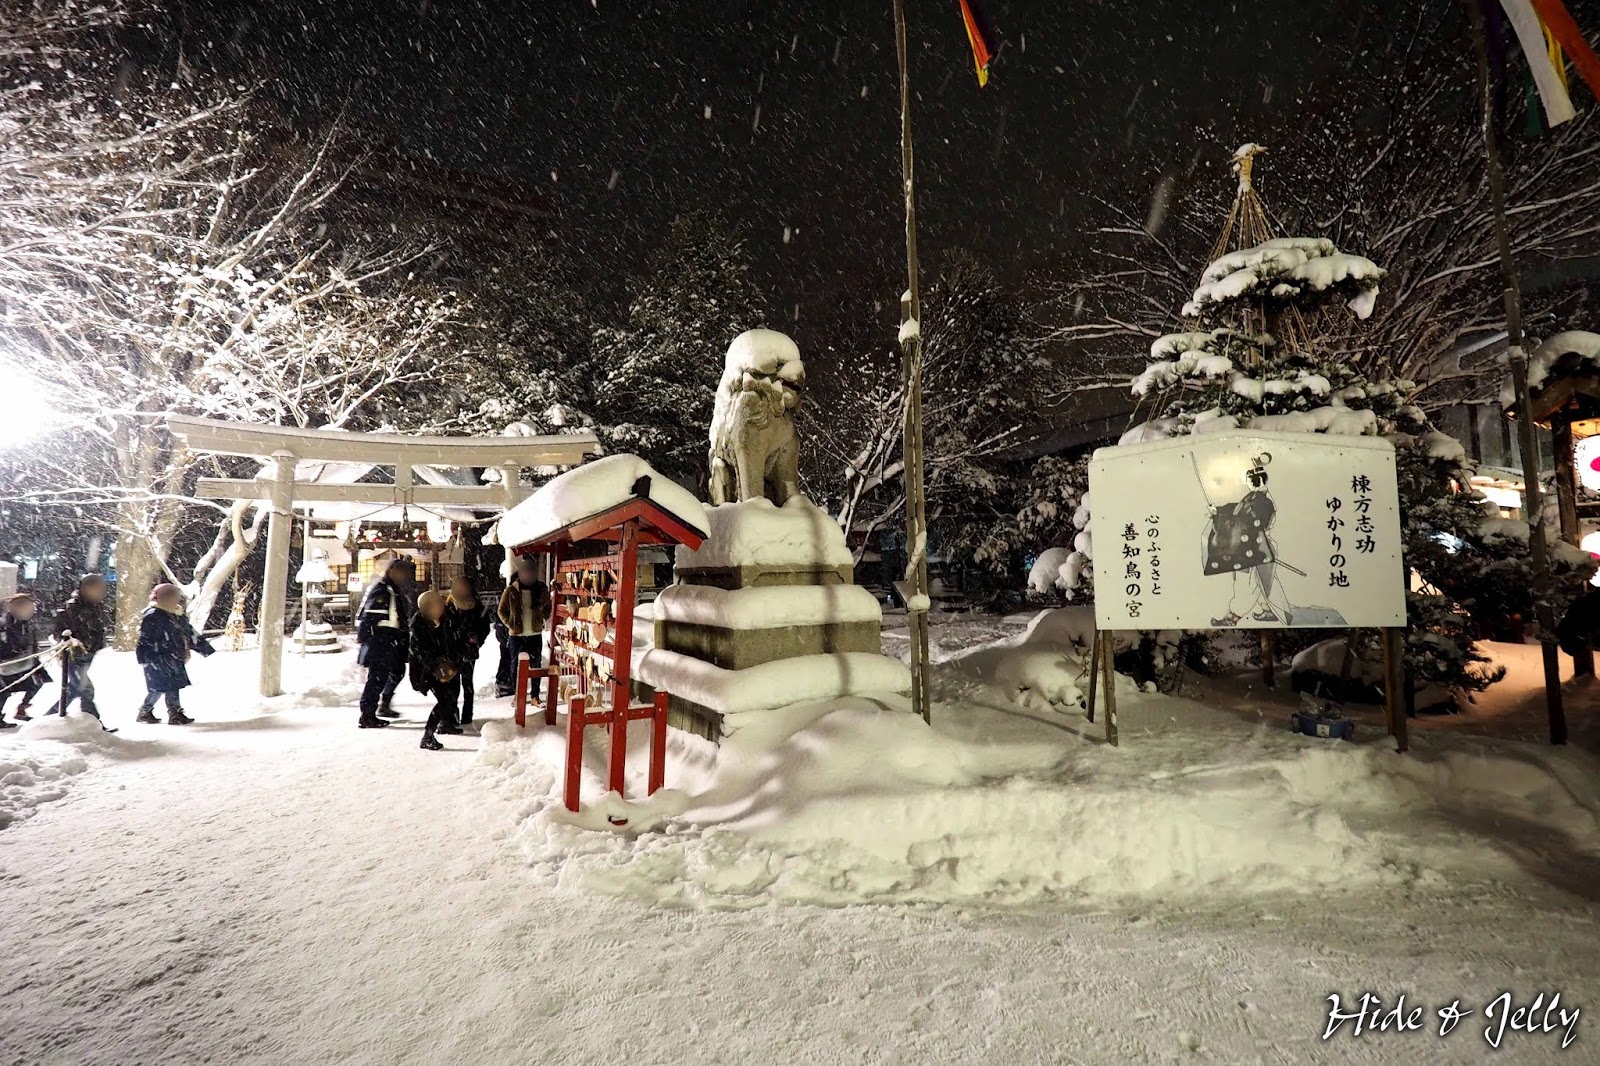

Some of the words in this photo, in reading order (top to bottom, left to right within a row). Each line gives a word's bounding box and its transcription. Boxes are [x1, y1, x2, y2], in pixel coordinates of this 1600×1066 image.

[1145, 514, 1161, 595] 心のふるさと
[1326, 497, 1350, 588] ゆかりの地
[1351, 474, 1376, 554] 棟方志功
[1121, 523, 1143, 618] 善知鳥の宮
